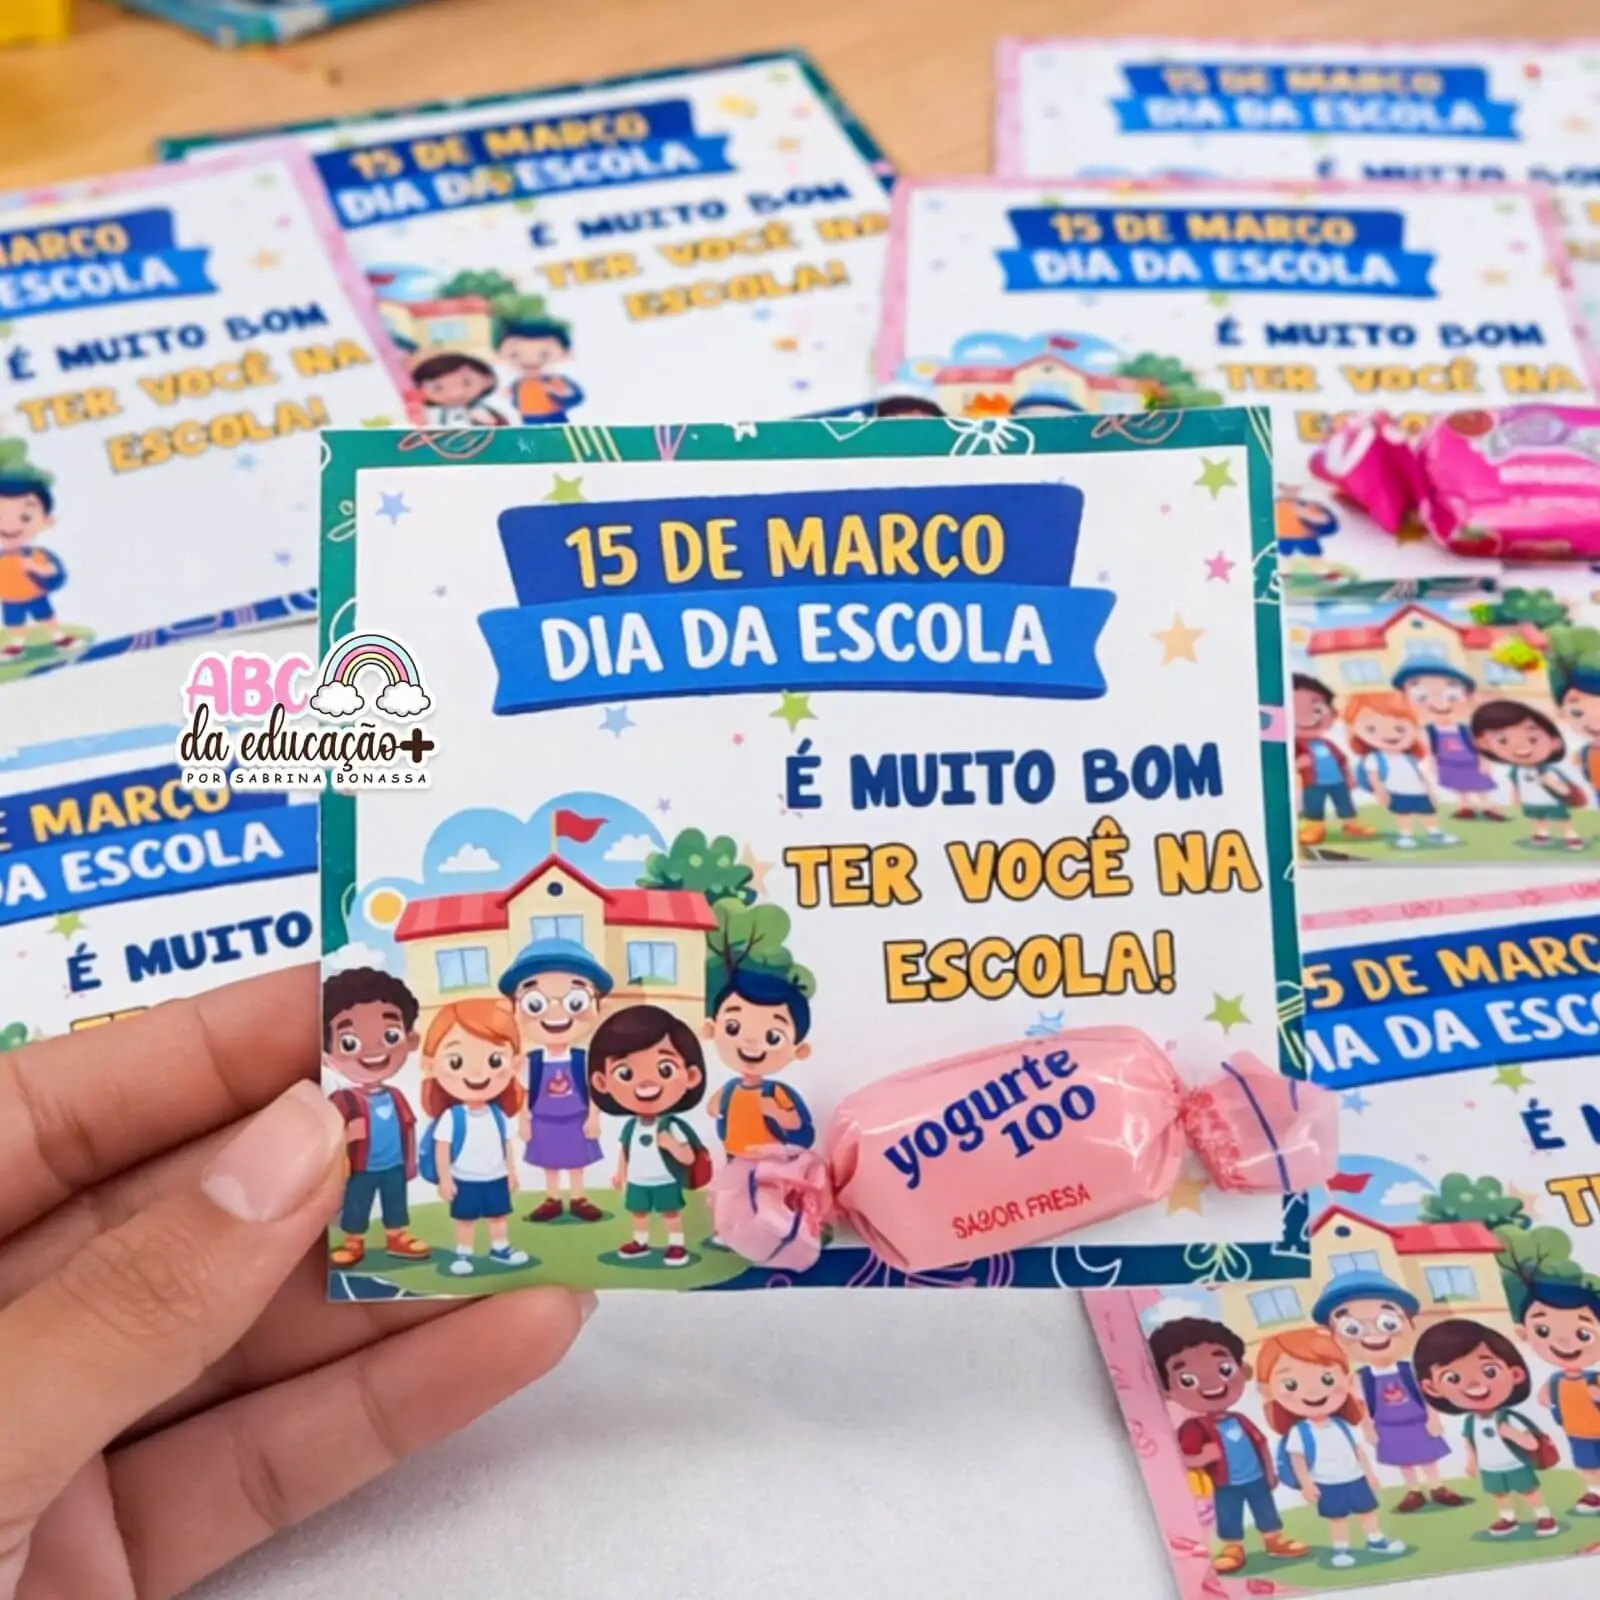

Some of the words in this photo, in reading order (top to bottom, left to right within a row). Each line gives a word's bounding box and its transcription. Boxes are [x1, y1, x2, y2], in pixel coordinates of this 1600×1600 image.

[1145, 97, 1228, 129] DIA
[1234, 98, 1301, 129] DA
[1311, 98, 1487, 132] ESCOLA
[336, 180, 430, 226] DIA
[513, 140, 702, 191] ESCOLA
[576, 199, 728, 240] MUITO
[1049, 213, 1101, 244] 15
[1115, 213, 1173, 245] DE
[537, 251, 643, 291] TER
[1031, 250, 1118, 285] DIA
[1130, 250, 1202, 286] DA
[1214, 251, 1400, 289] ESCOLA
[7, 346, 35, 382] É
[55, 323, 207, 373] MUITO
[225, 302, 329, 343] BOM
[1217, 316, 1242, 346] É
[1265, 322, 1416, 348] MUITO
[1440, 321, 1546, 347] BOM
[18, 386, 122, 434] TER
[138, 348, 281, 408] VOCÊ
[290, 337, 374, 378] NA
[1215, 360, 1320, 393] TER
[1337, 357, 1482, 394] VOCÊ
[1500, 361, 1587, 393] NA
[105, 396, 332, 475] ESCOLA!
[564, 525, 638, 590] 15
[659, 518, 743, 585] DE
[767, 513, 1006, 580] MARÇO
[540, 610, 664, 683] DIA
[681, 605, 778, 670] DA
[799, 602, 1054, 665] ESCOLA
[785, 738, 822, 810] É
[850, 748, 1056, 810] MUITO
[1082, 742, 1224, 804] BOM
[61, 821, 284, 894] ESCOLA
[783, 843, 922, 909] TER
[944, 815, 1134, 903] VOCÊ
[1154, 829, 1263, 896] NA
[66, 943, 103, 993] É
[124, 910, 314, 984] MUITO
[883, 928, 1177, 1004] ESCOLA!
[1352, 954, 1429, 1002] DE
[1304, 1024, 1381, 1074] IA
[1384, 1008, 1482, 1061] DA
[1485, 992, 1600, 1045] ESC
[882, 1047, 1080, 1190] yogurte
[1000, 1083, 1097, 1159] 100
[1025, 1182, 1092, 1218] FRESA
